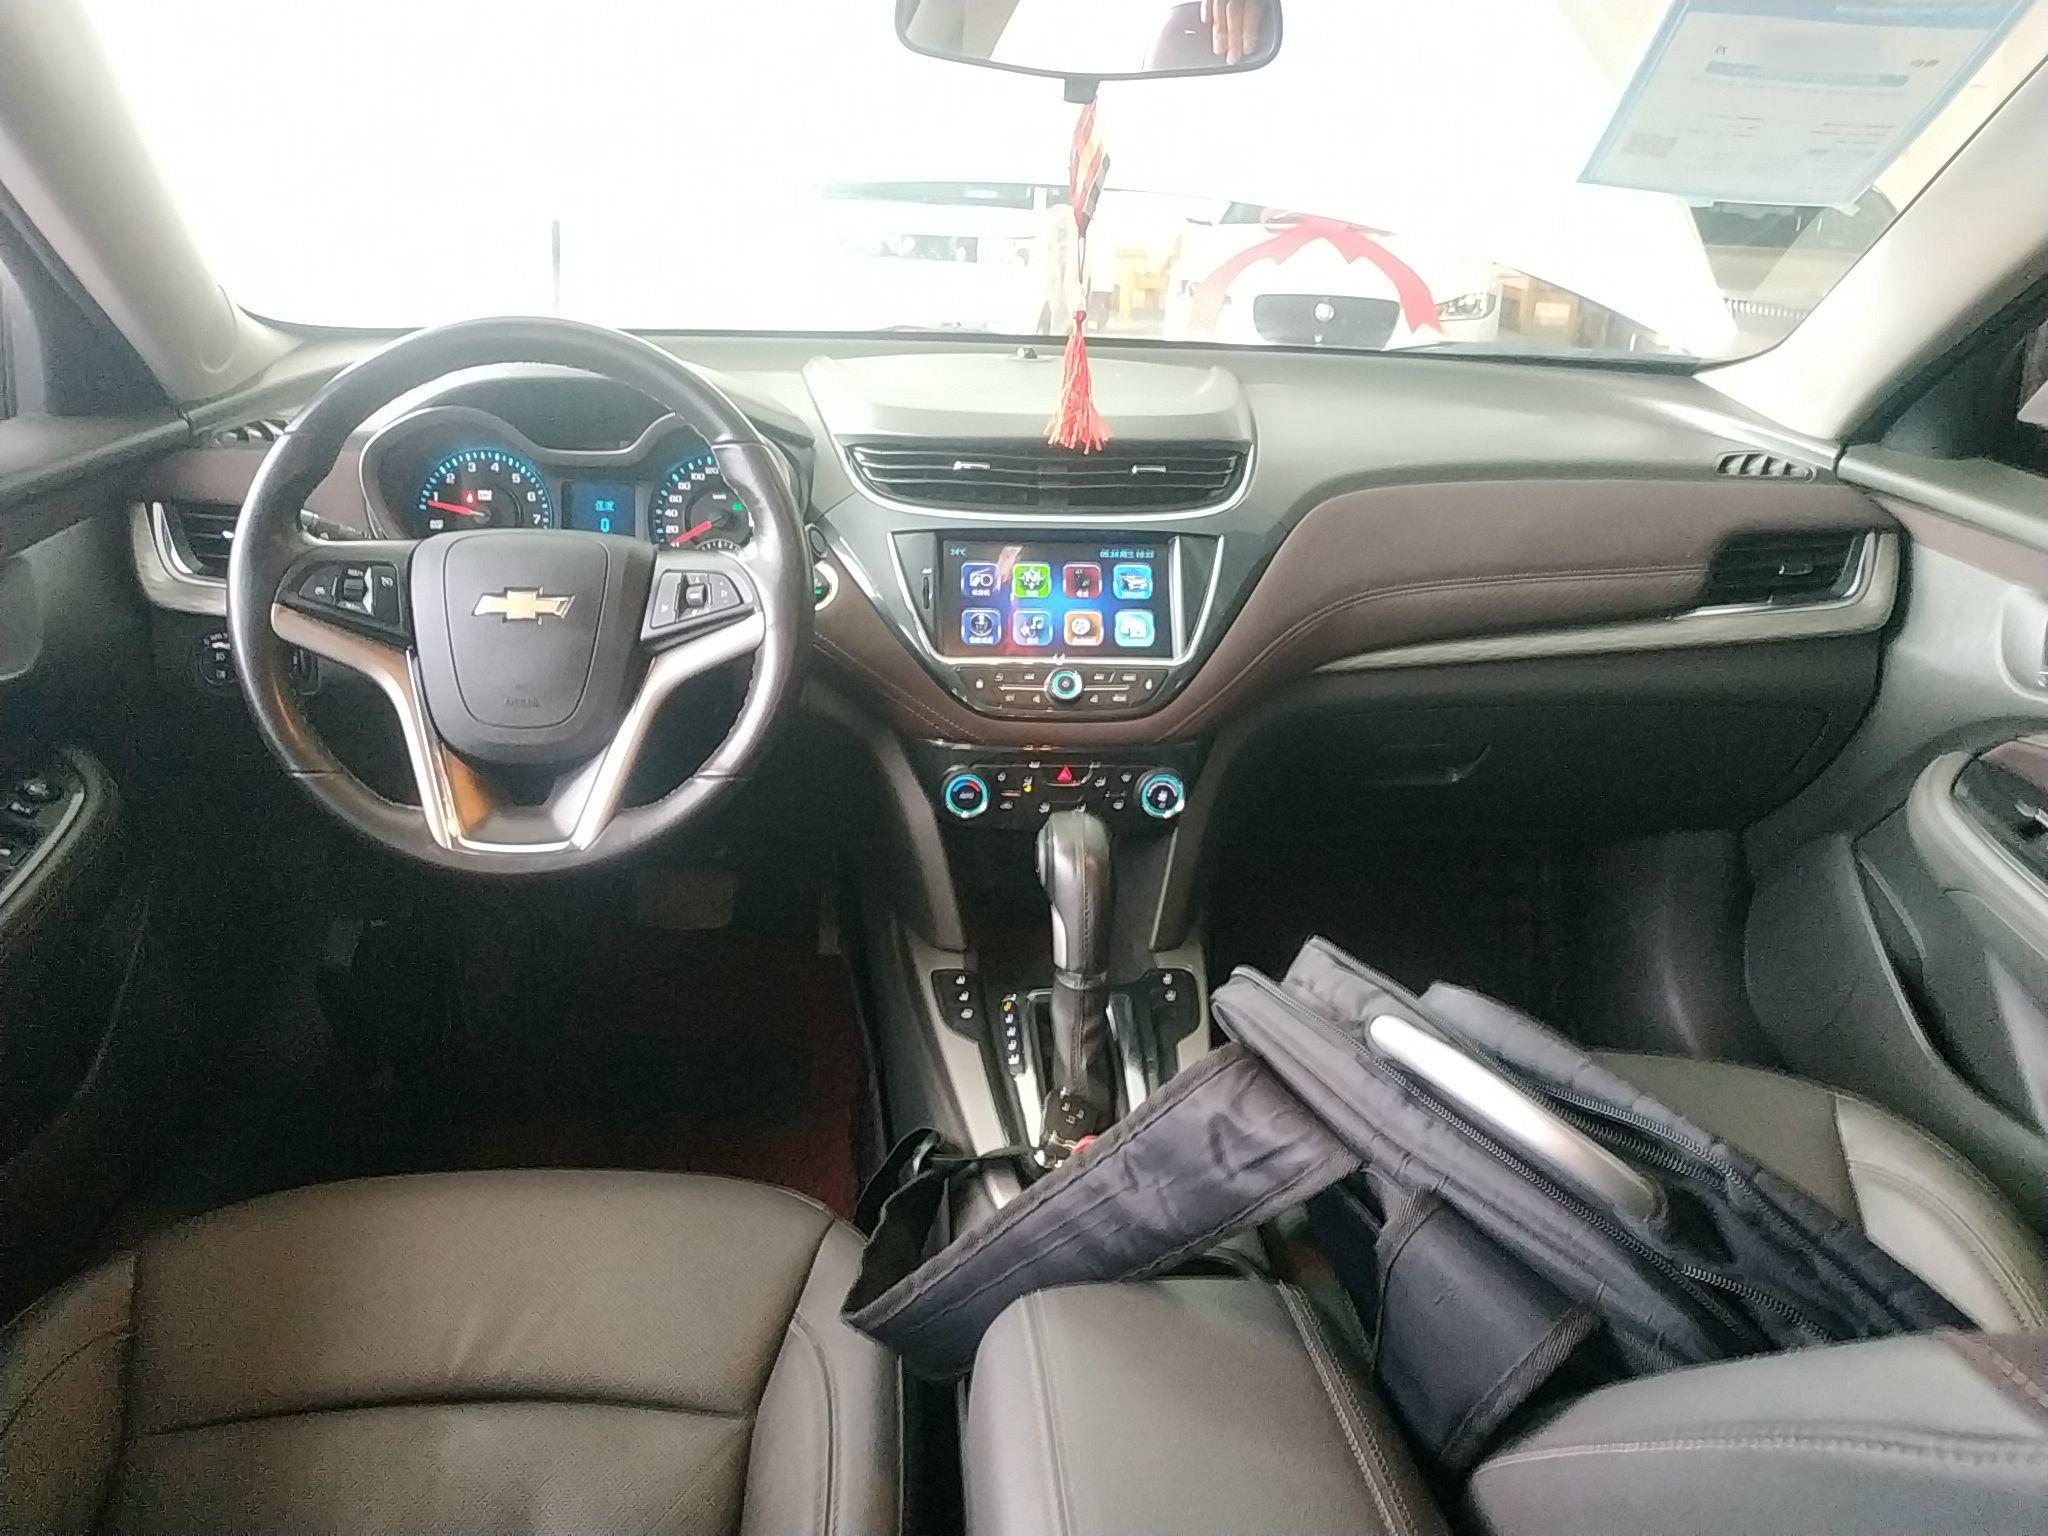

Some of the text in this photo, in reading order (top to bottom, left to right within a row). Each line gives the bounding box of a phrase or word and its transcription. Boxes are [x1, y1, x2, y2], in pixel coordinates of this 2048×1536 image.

[467, 461, 477, 473] 3
[490, 461, 500, 473] 4
[445, 472, 456, 484] 2
[511, 472, 521, 484] 5
[690, 473, 705, 481] 100
[432, 490, 439, 501] 1
[526, 491, 536, 502] 6
[532, 513, 541, 525] 7
[665, 509, 678, 517] 40
[600, 517, 610, 533] 0
[666, 525, 679, 533] 20
